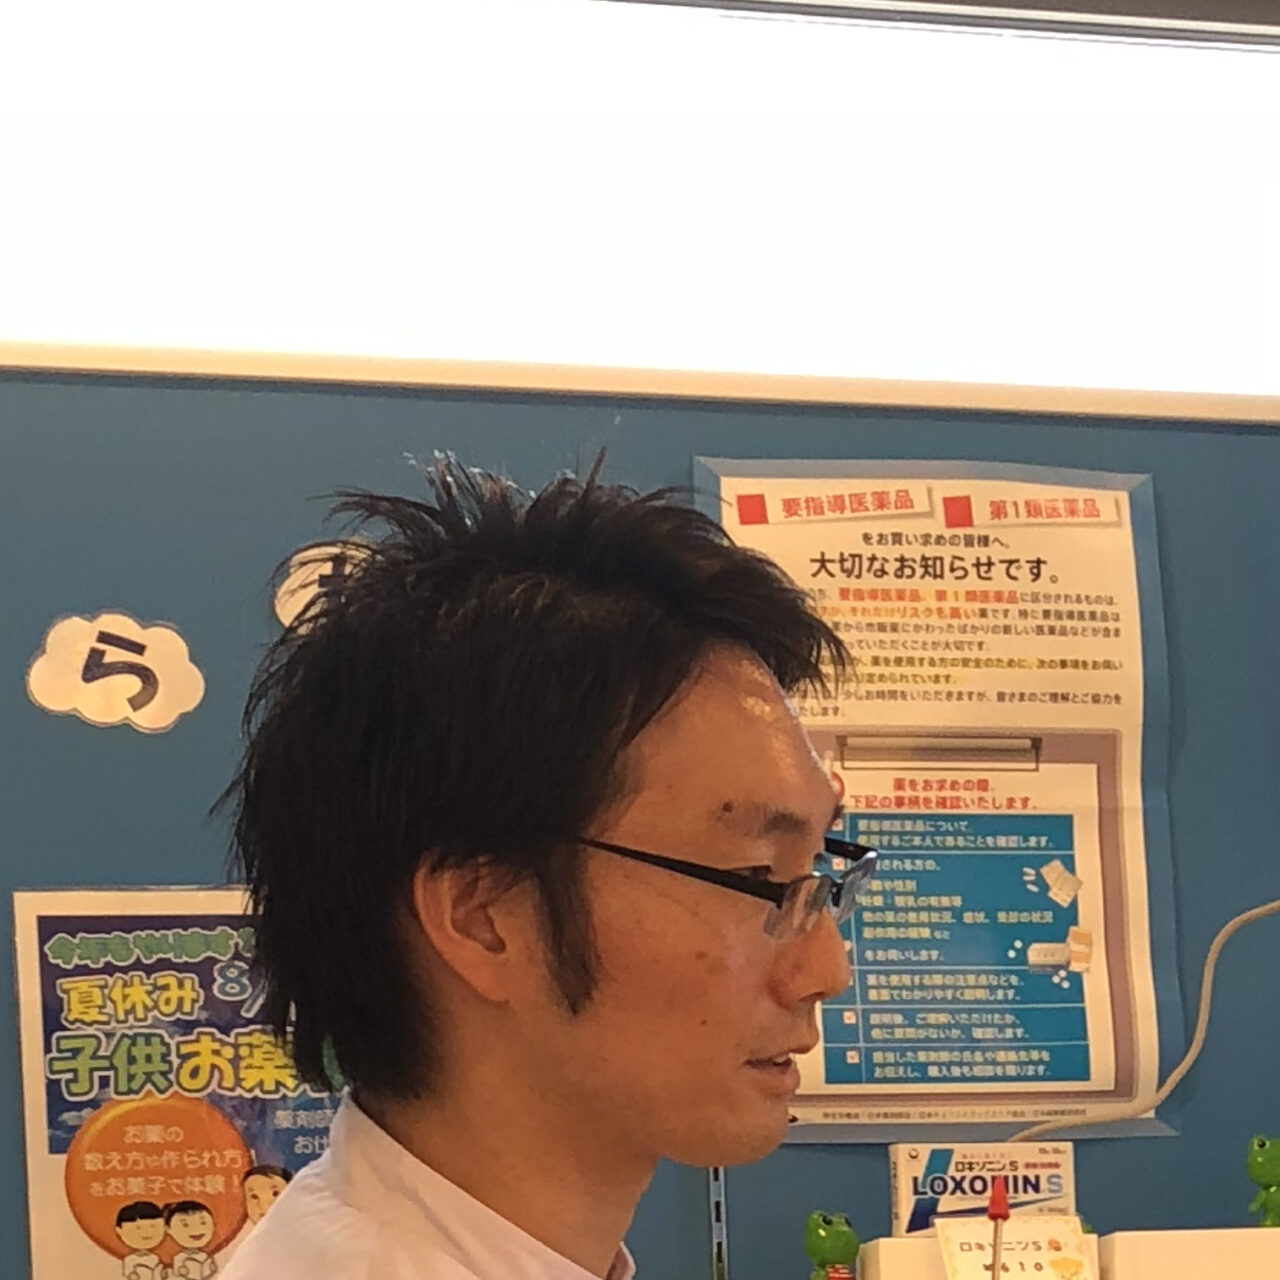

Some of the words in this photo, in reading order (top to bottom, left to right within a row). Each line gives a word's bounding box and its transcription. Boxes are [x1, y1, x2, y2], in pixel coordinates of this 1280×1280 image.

[780, 489, 916, 520] 要指導医薬品
[988, 497, 1102, 522] 第1類医薬品
[860, 531, 1012, 550] をお買い求めの皆様へ。
[809, 551, 1061, 584] 大切なお知らせです。
[80, 629, 160, 713] ら
[58, 973, 201, 1027] 夏休み
[122, 1124, 185, 1144] お薬の
[954, 1160, 1019, 1173] ロキソニンS
